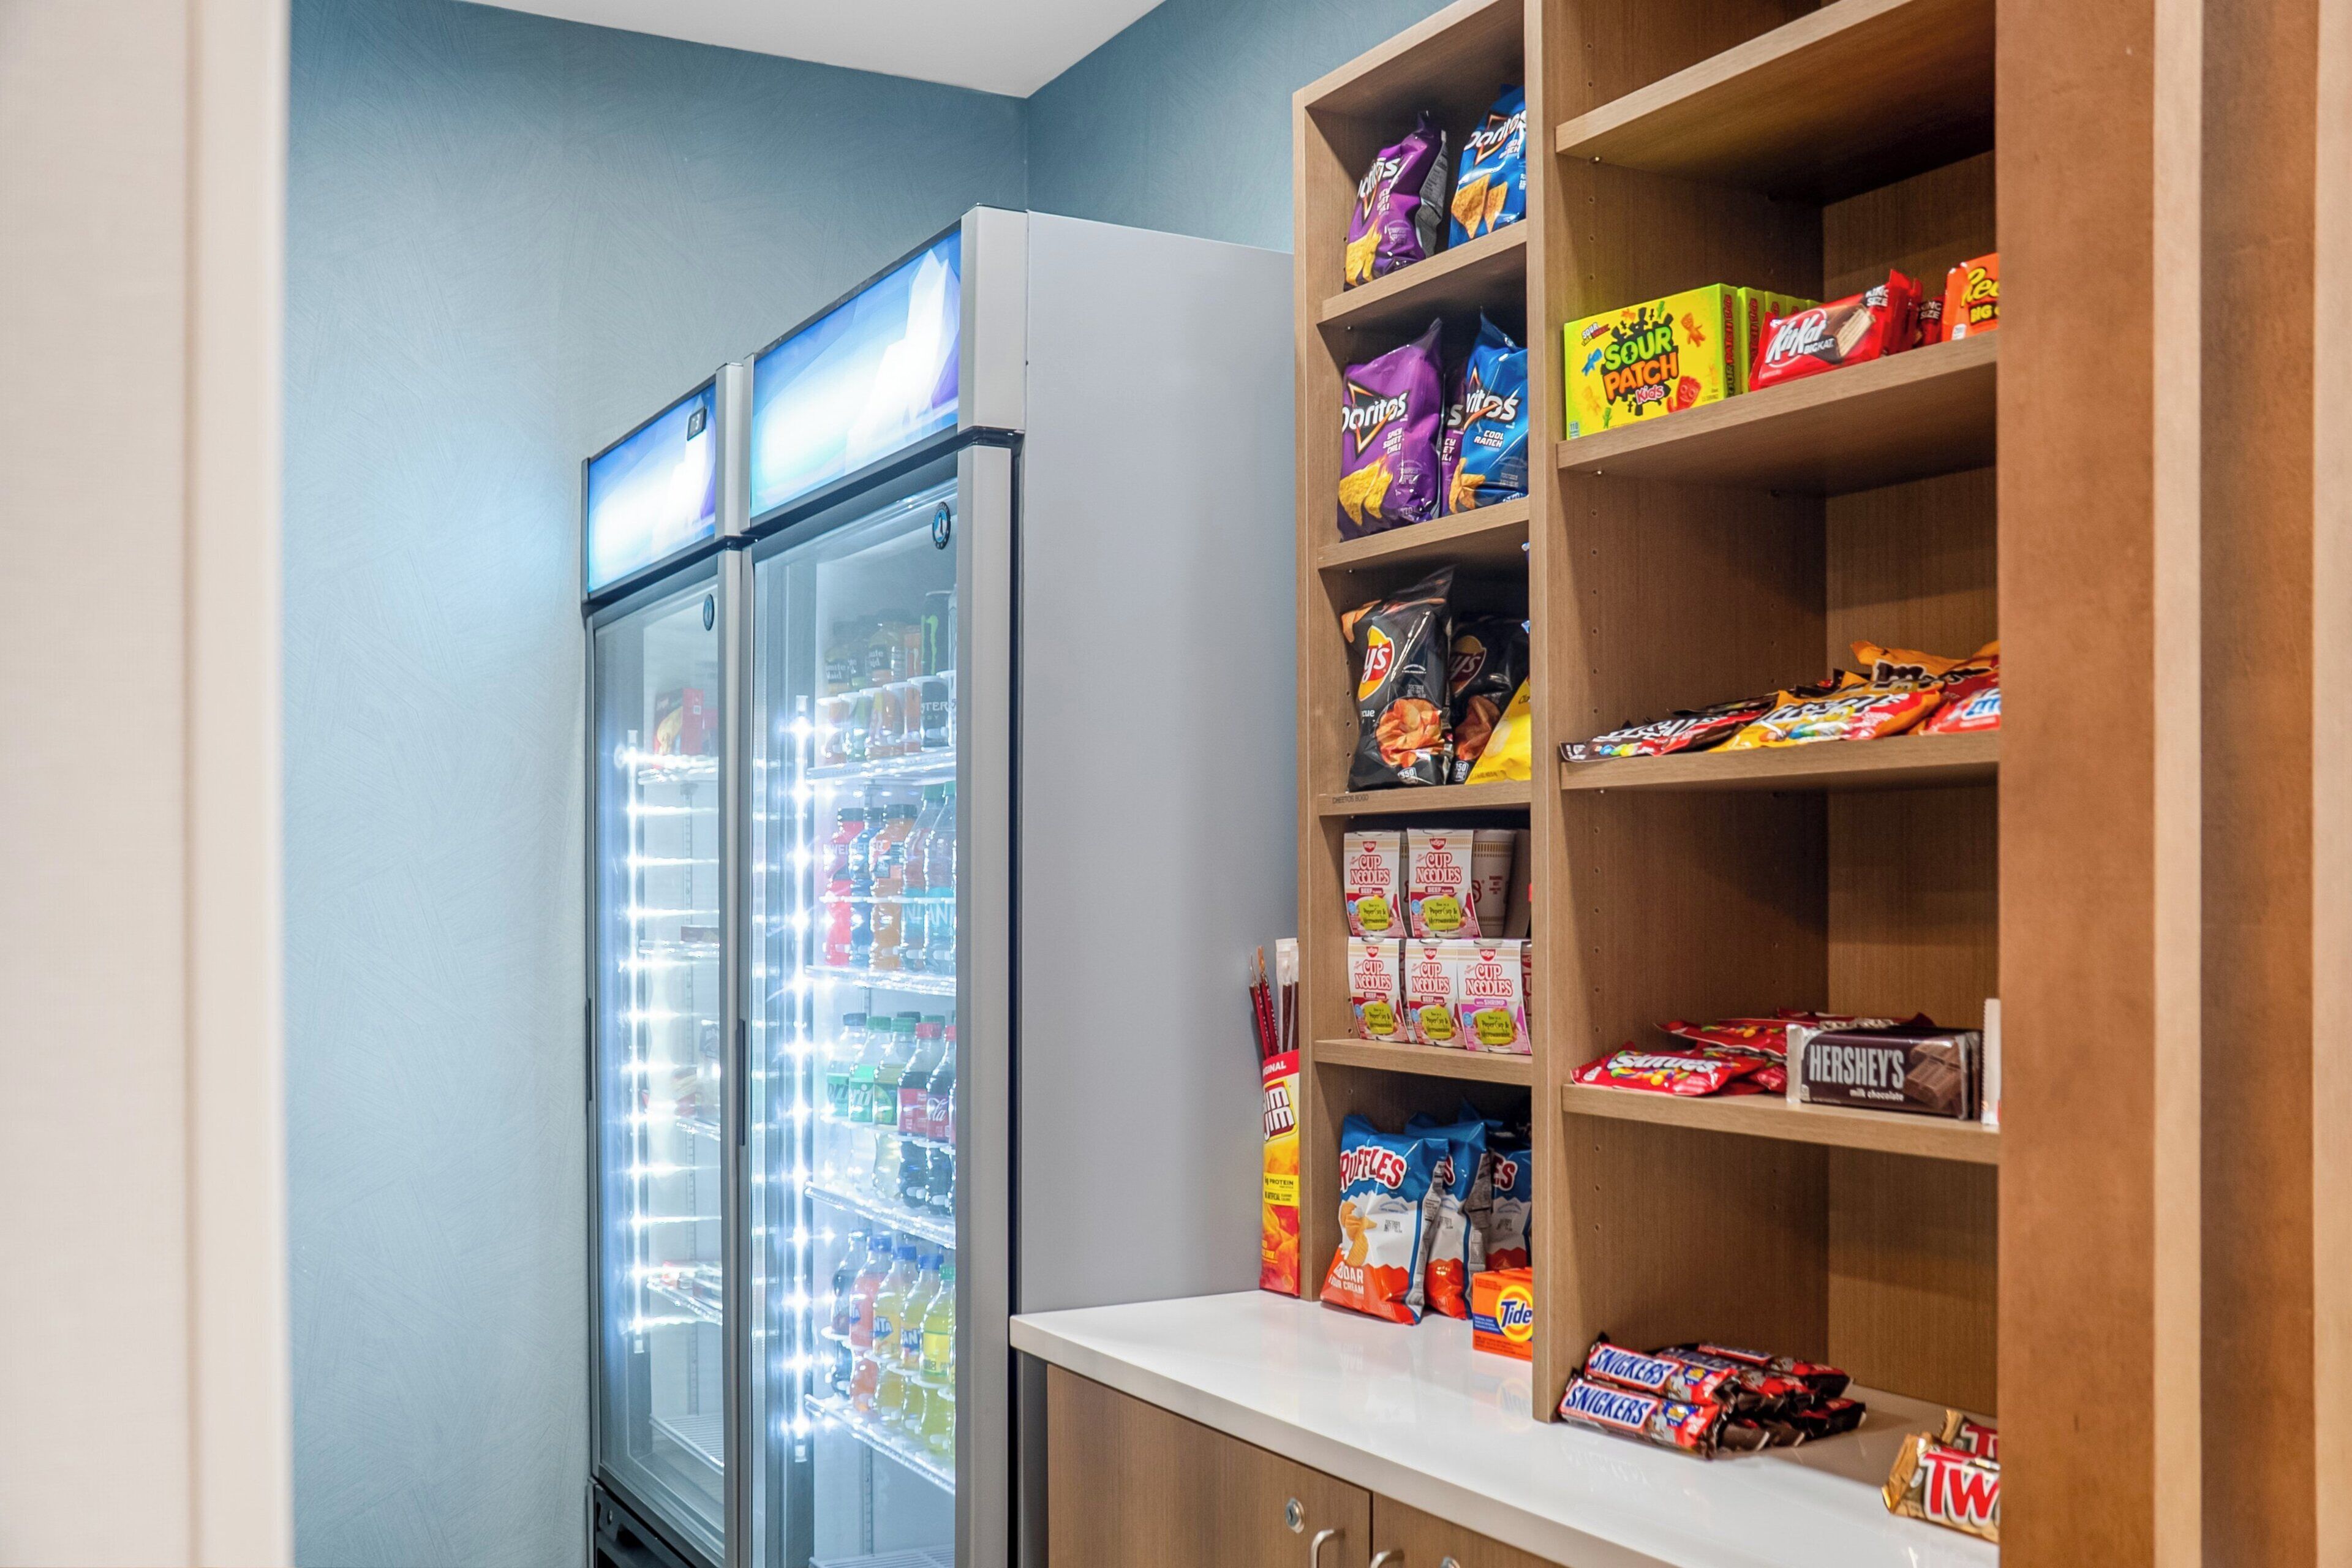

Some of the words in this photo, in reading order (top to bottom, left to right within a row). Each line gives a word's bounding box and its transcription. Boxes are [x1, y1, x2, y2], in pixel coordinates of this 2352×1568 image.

[1357, 157, 1401, 198] oritos
[1604, 326, 1673, 371] SOUR
[1602, 351, 1679, 404] PATCH
[1635, 384, 1665, 405] Kids
[1466, 389, 1519, 421] ritos
[1474, 435, 1504, 448] RANCH
[1483, 429, 1504, 440] COOL
[1362, 644, 1390, 684] y's
[1359, 854, 1382, 870] CUP
[1425, 852, 1453, 868] CUP
[1350, 869, 1391, 885] NOODLES
[1415, 867, 1462, 884] NOODLES
[1362, 959, 1384, 974] CUP
[1420, 962, 1442, 978] CUP
[1475, 963, 1502, 980] CUP
[1354, 973, 1392, 990] NOODLES
[1412, 976, 1450, 995] NOODLES
[1465, 978, 1513, 997] NOODLES
[1809, 1044, 1905, 1090] HERSHEY'S
[1849, 1088, 1866, 1099] milk
[1868, 1090, 1904, 1102] chocolate
[1340, 1145, 1408, 1193] RUFFLES
[1493, 1153, 1518, 1191] ES
[1343, 1281, 1365, 1295] CREAM
[1499, 1300, 1532, 1328] Tide
[874, 1315, 894, 1333] NTA
[1589, 1348, 1674, 1385] SNICKERS
[1565, 1385, 1653, 1425] SNICKERS
